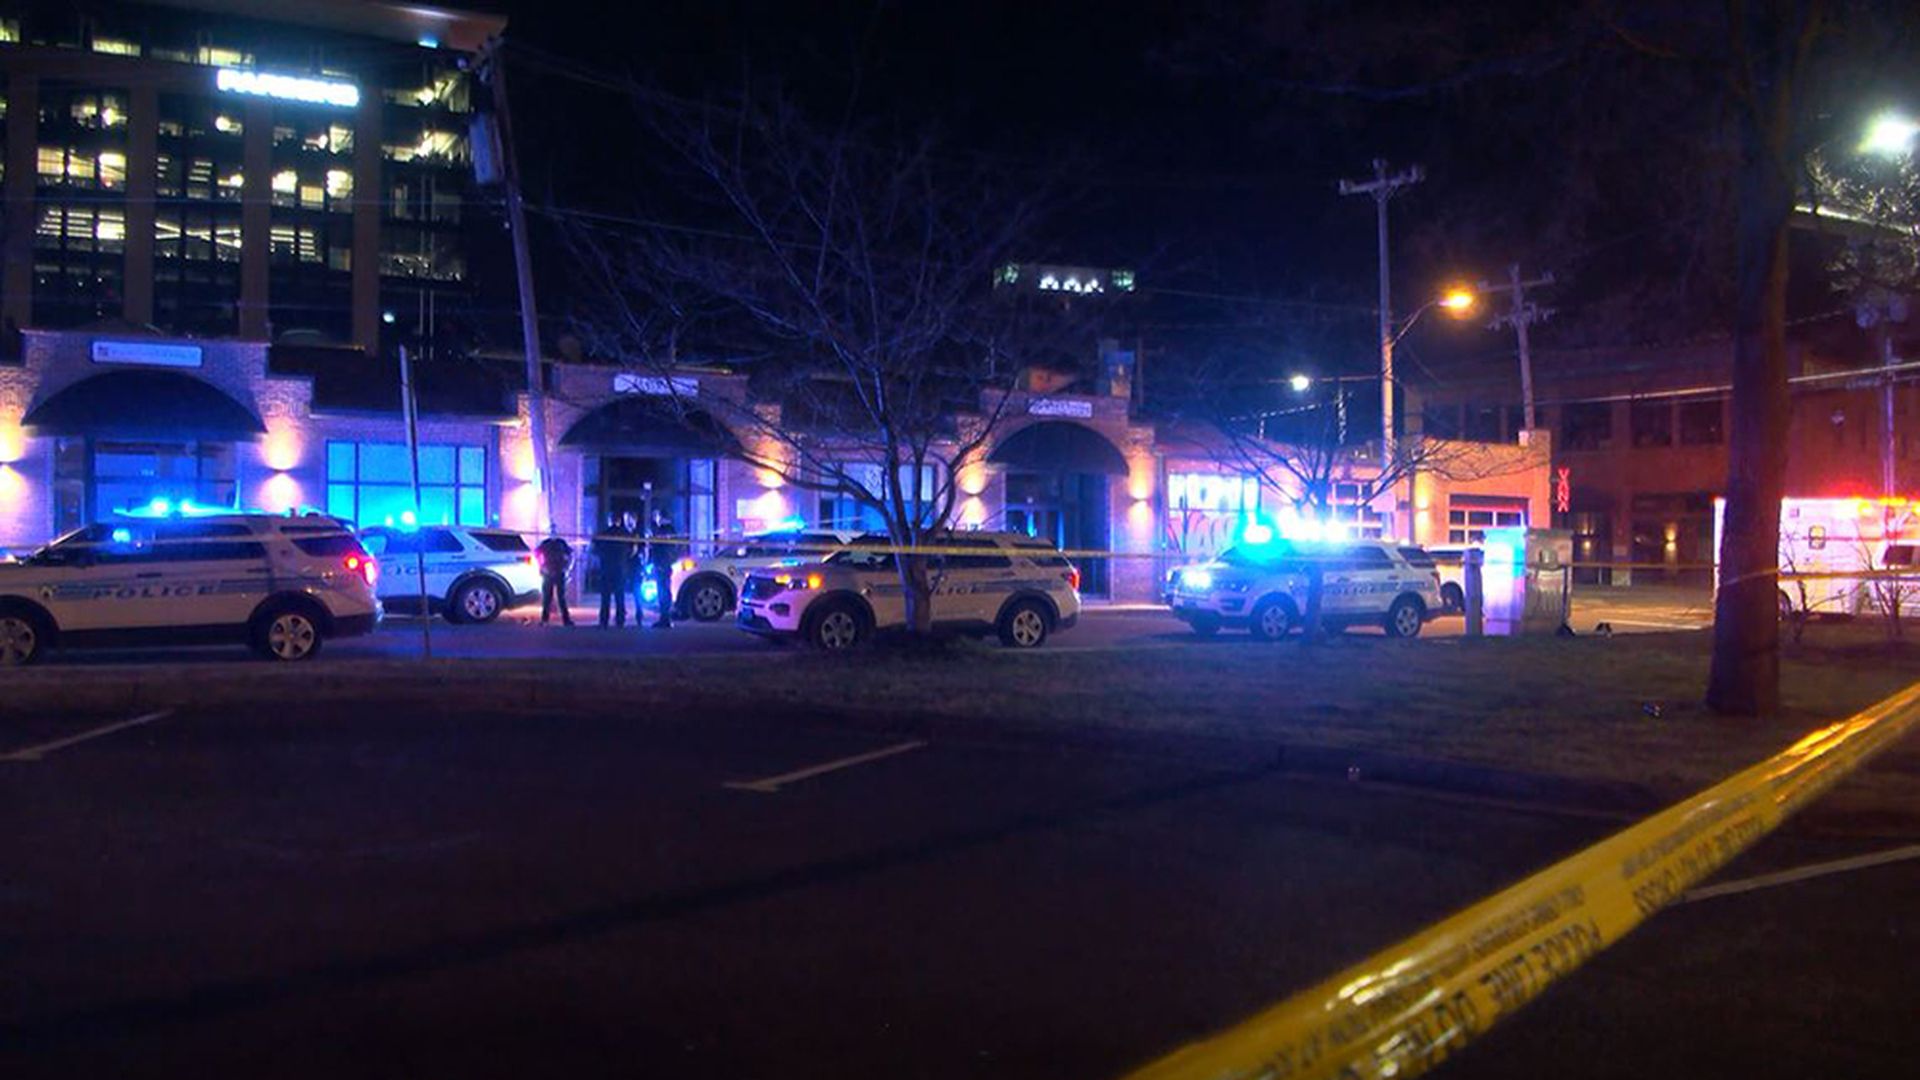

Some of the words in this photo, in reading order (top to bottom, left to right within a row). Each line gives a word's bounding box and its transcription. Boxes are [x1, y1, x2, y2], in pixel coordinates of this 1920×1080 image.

[93, 584, 216, 599] POLICE
[934, 583, 978, 596] LICE
[1476, 952, 1543, 1017] LINE
